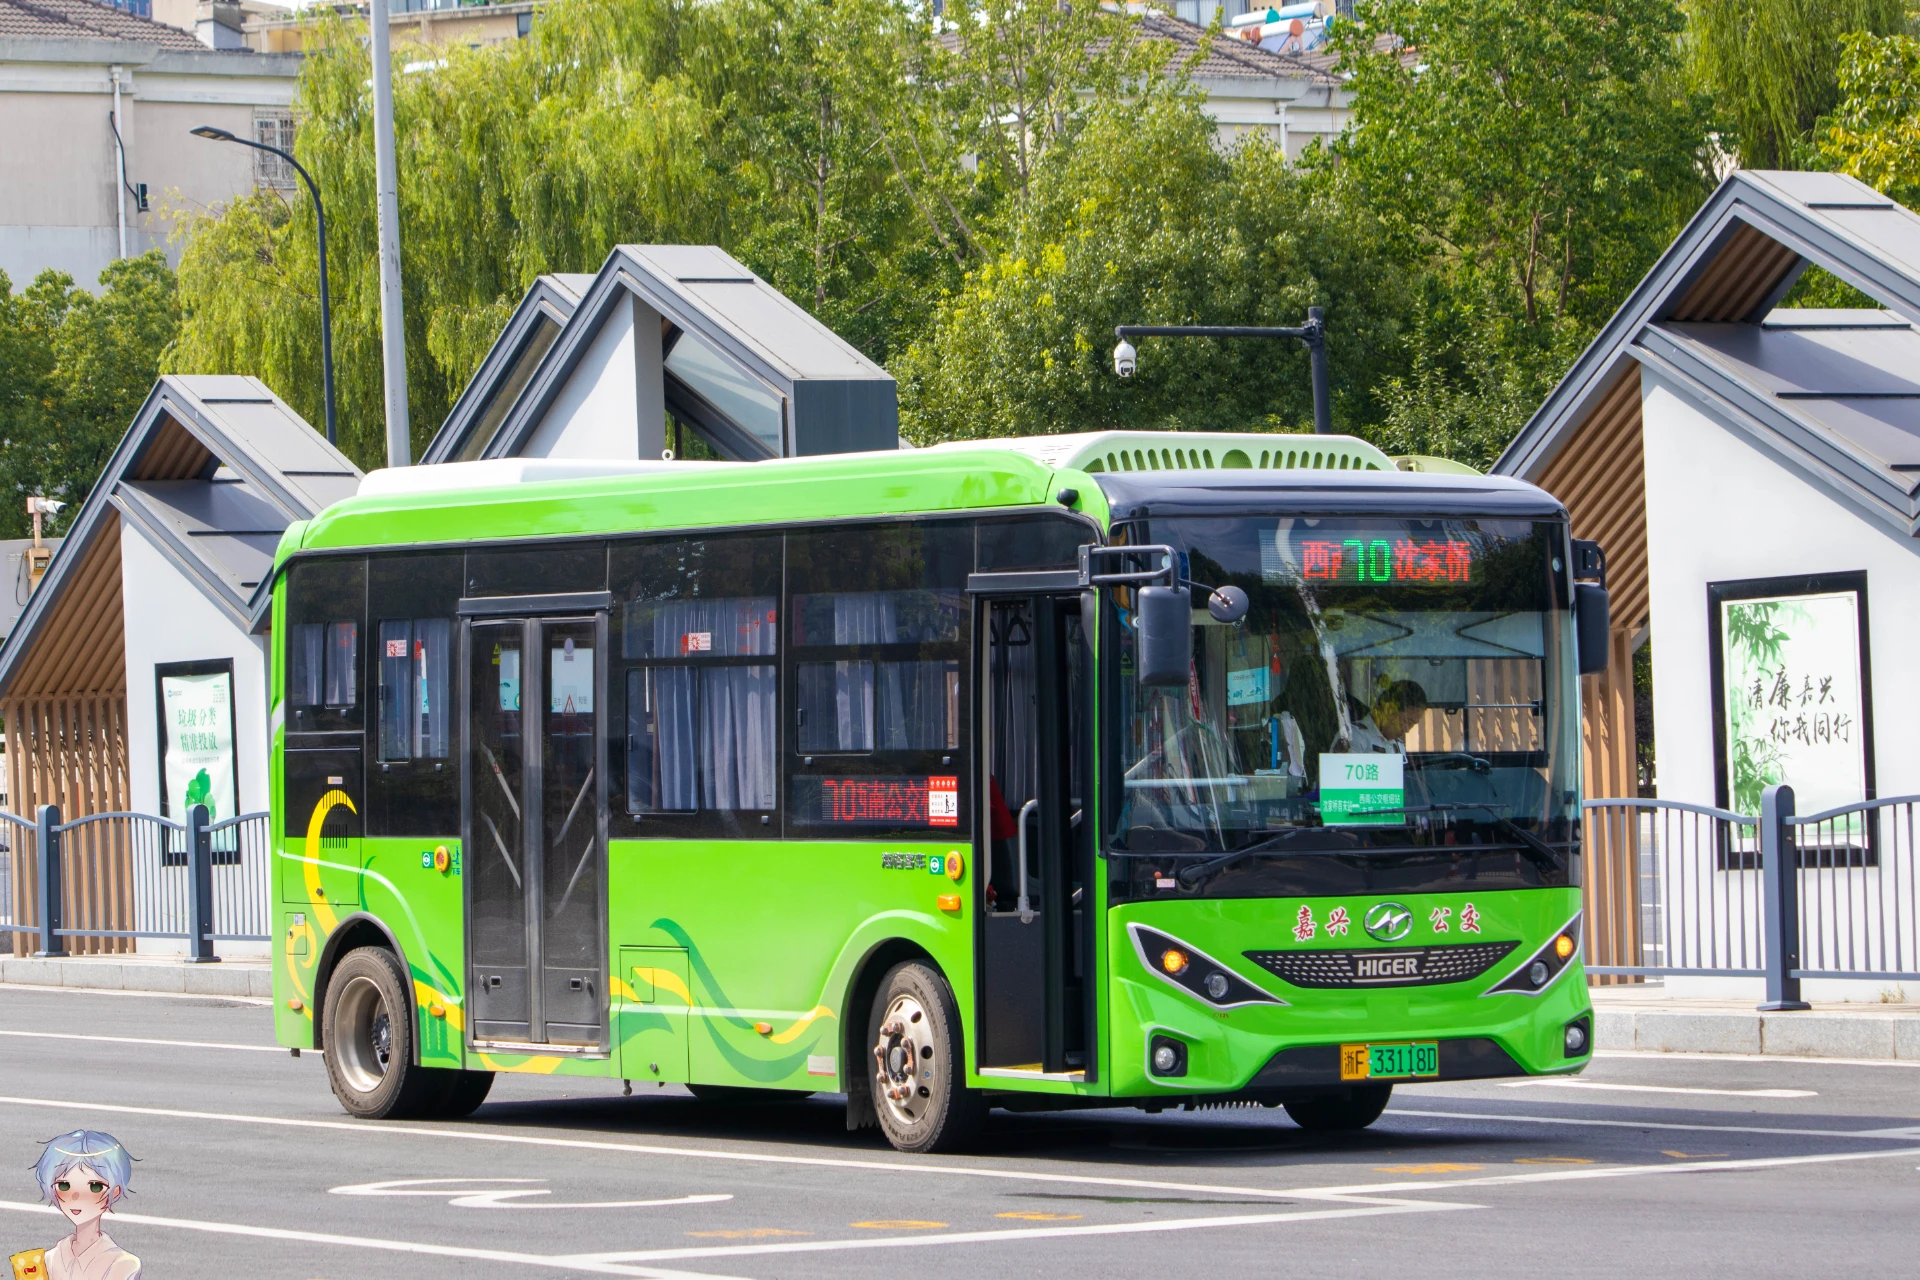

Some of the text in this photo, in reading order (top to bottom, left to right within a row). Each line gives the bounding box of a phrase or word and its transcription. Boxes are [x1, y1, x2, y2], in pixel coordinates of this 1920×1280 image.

[1343, 539, 1391, 582] 70
[1393, 539, 1472, 582] 沈家桥
[1747, 664, 1836, 710] 清廉嘉兴
[178, 707, 217, 726] 垃圾分类
[1770, 711, 1853, 746] 你我同行
[180, 731, 218, 752] 精准投放
[1344, 763, 1380, 782] 70路
[1292, 902, 1481, 942] 嘉兴 公交
[1357, 958, 1418, 977] HIGER
